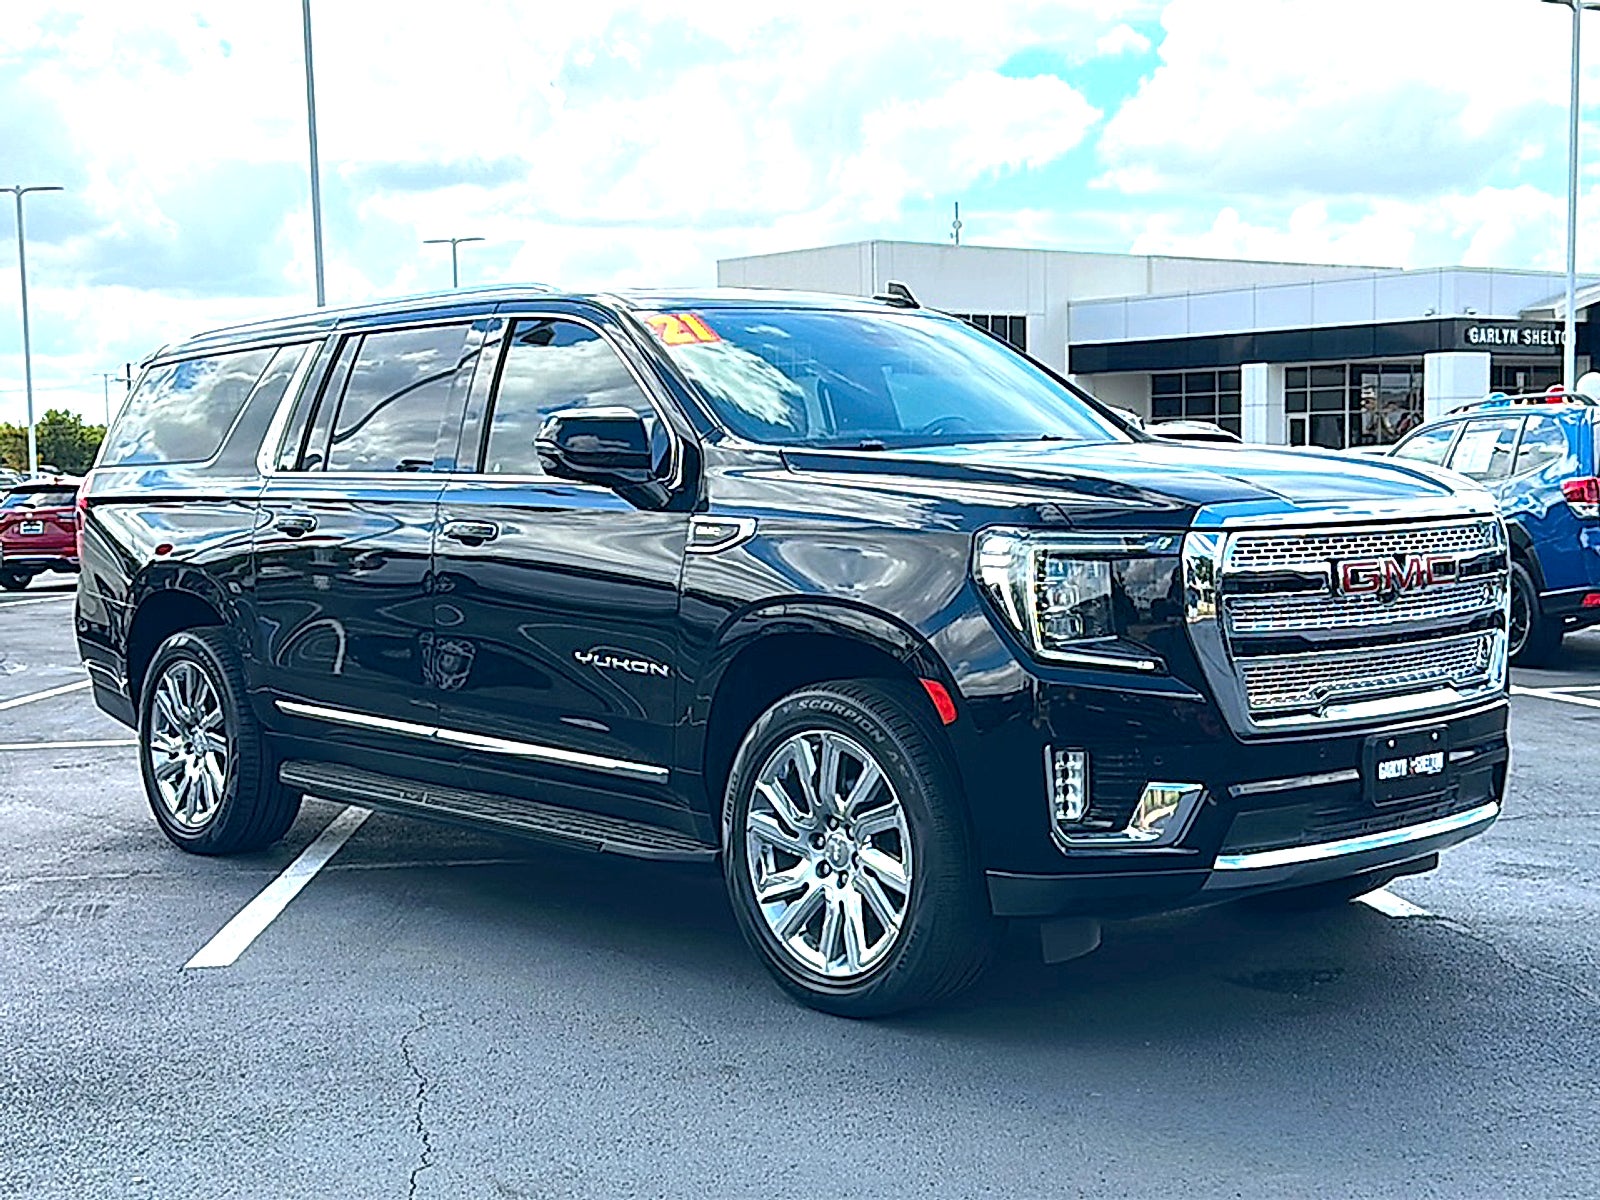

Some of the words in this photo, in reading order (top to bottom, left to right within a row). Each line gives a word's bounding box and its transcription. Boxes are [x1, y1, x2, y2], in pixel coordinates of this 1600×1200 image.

[647, 313, 721, 347] 21
[1469, 327, 1518, 344] GARLYN
[1340, 555, 1457, 595] GMC
[574, 651, 669, 678] YUKON
[798, 700, 885, 743] SCORPION
